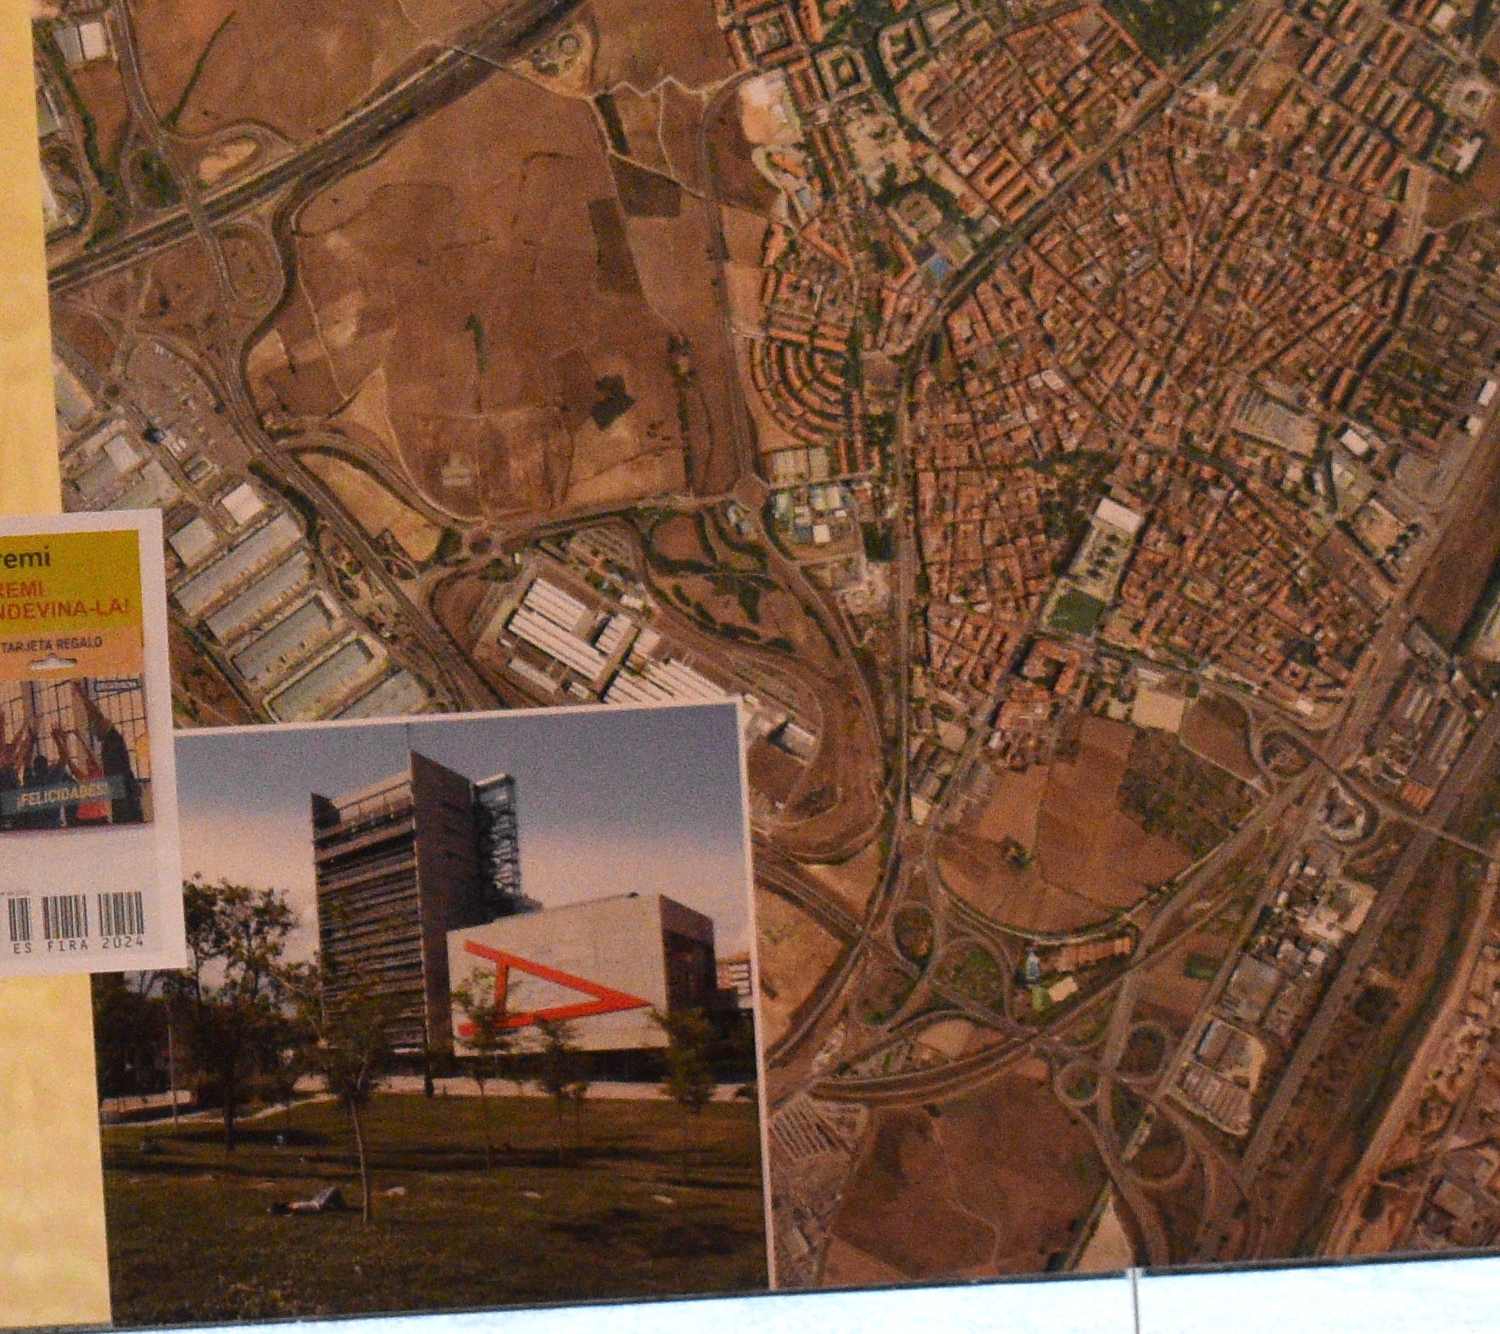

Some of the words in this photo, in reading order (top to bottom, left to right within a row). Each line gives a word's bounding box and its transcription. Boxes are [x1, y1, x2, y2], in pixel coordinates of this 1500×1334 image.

[1, 638, 53, 654] TARJETA
[56, 635, 103, 650] REGALO
[13, 942, 32, 955] ES
[47, 939, 89, 953] FIRA
[102, 935, 145, 950] 2024
